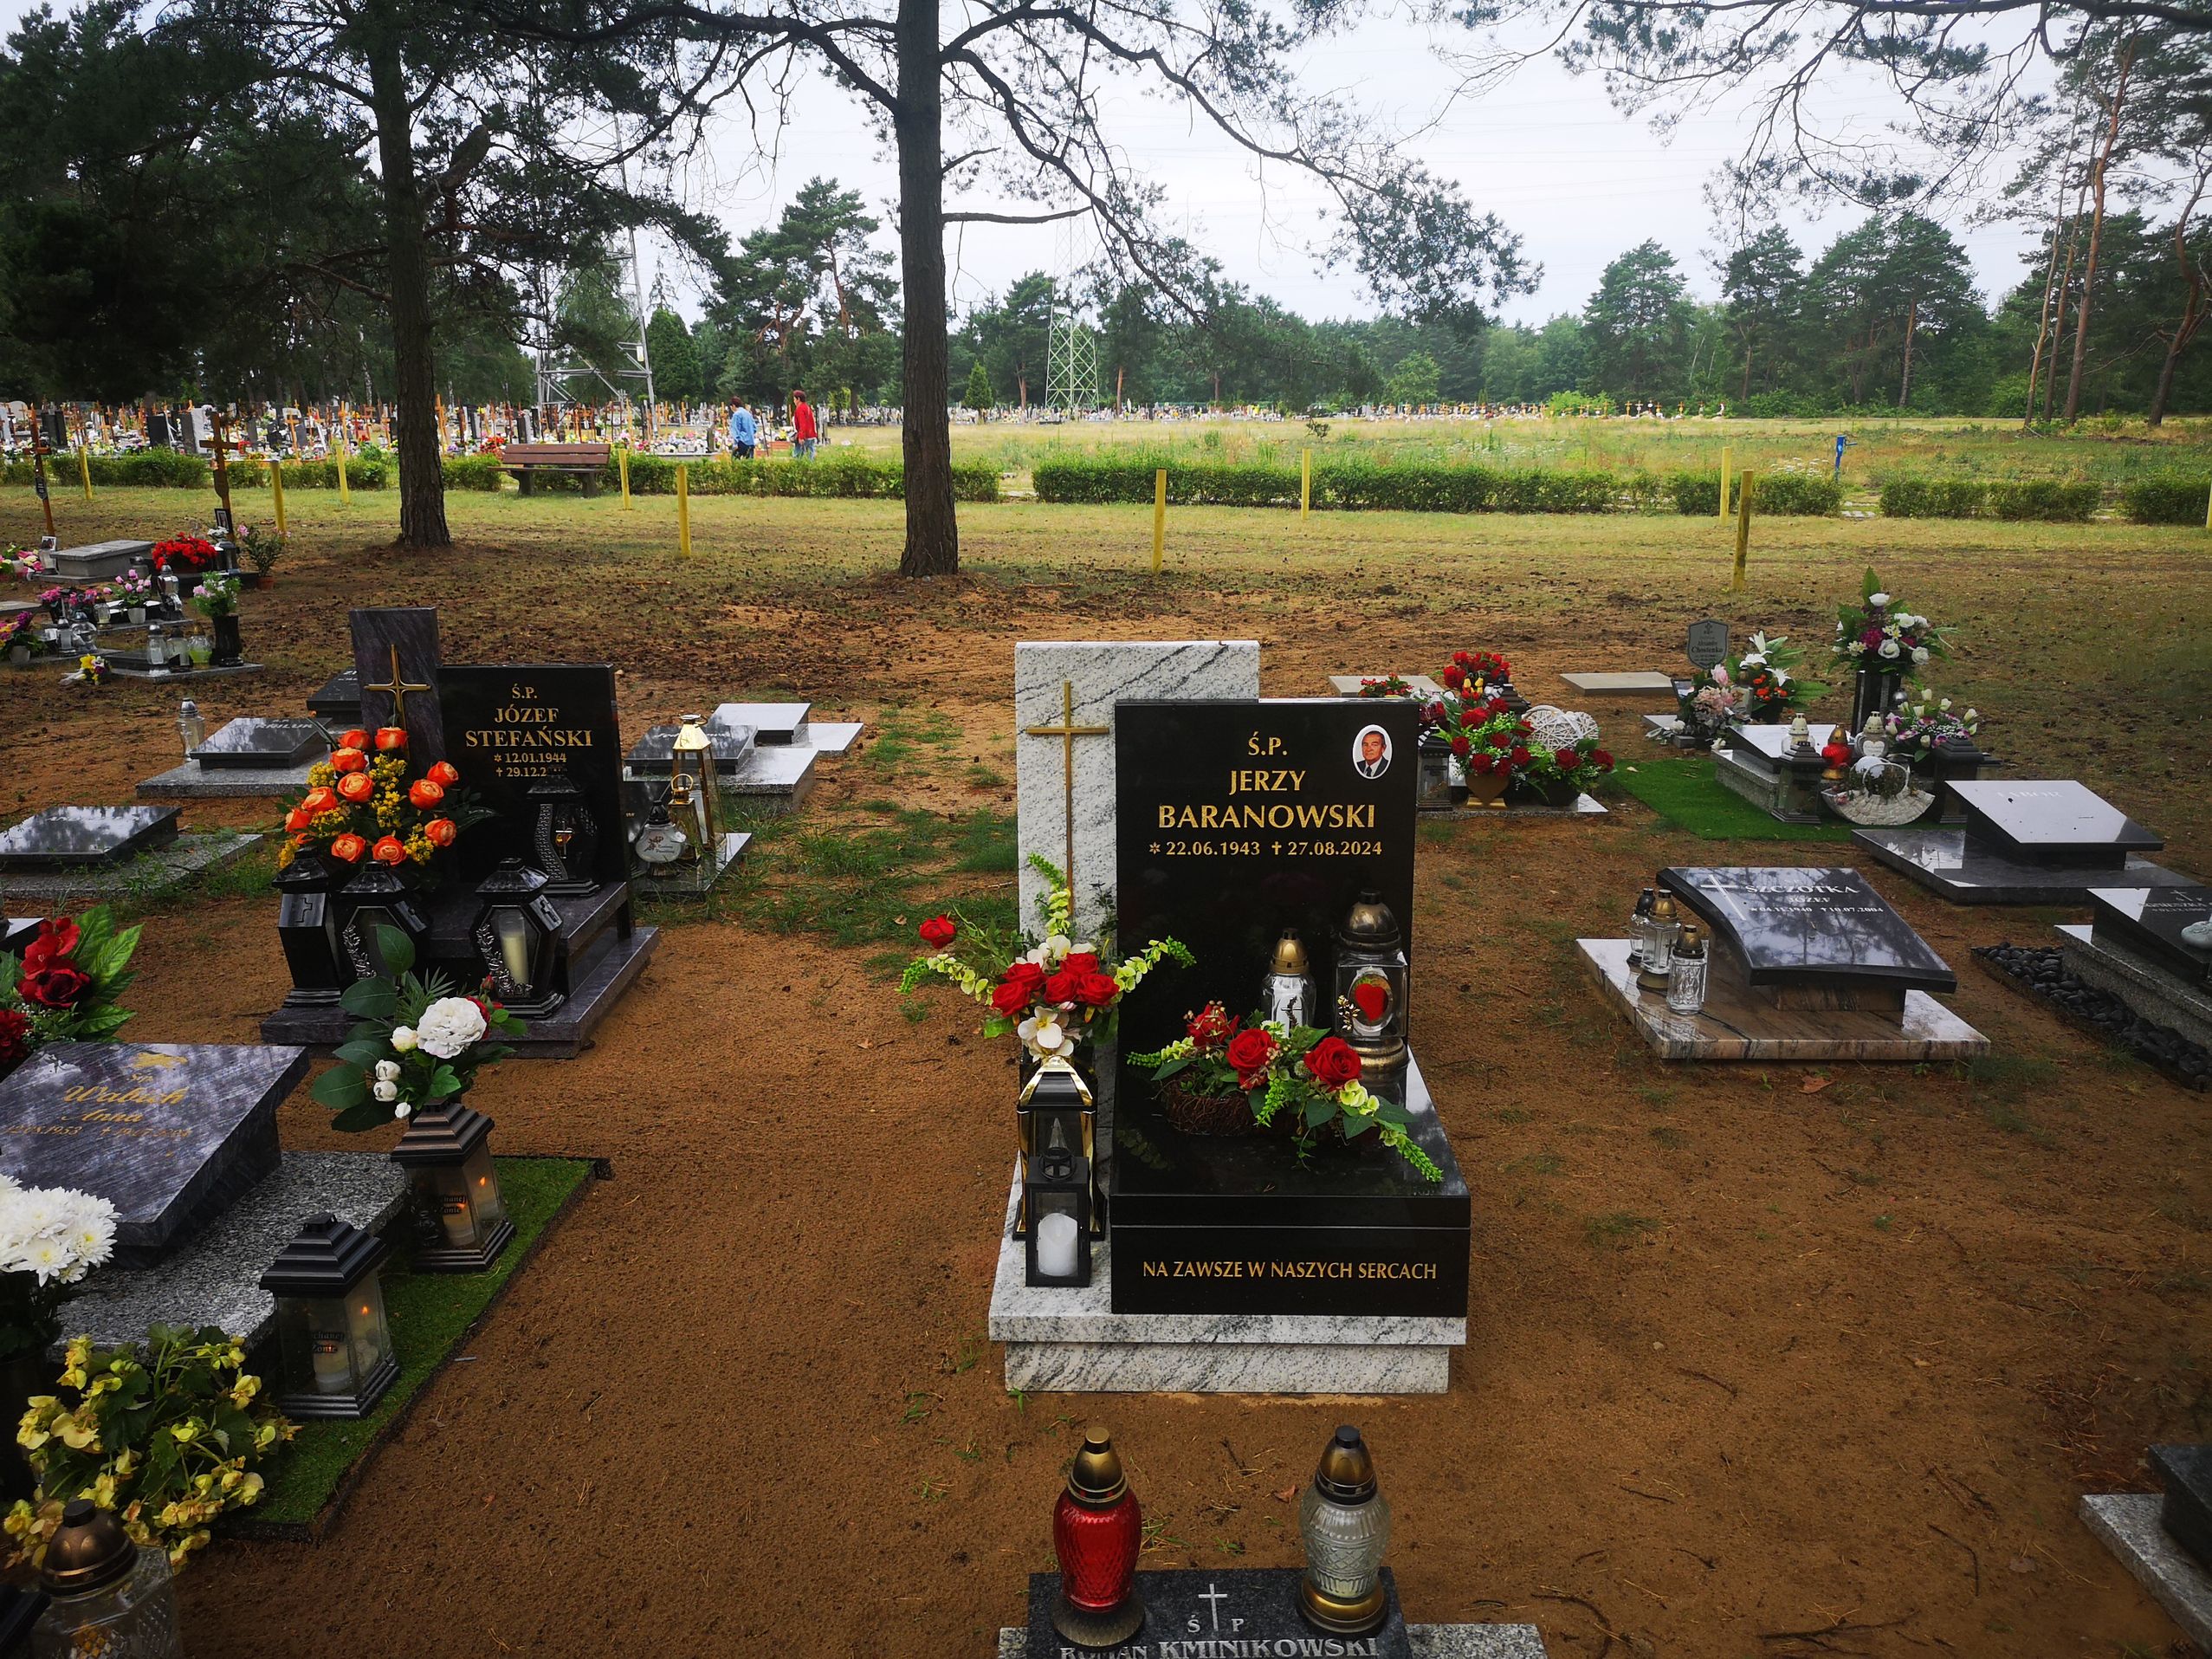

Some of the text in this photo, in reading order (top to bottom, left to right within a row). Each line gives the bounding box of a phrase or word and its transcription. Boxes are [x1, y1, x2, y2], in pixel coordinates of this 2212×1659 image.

[512, 683, 538, 699] Ś.P.
[494, 703, 559, 723] JÓZEF
[465, 725, 593, 748] STEFAŃSKI
[1247, 730, 1288, 756] Ś.P.
[505, 752, 567, 763] 12.01.1944
[506, 767, 549, 778] 29.12.2
[1228, 769, 1306, 796] JERZY
[1158, 804, 1375, 829] BARANOWSKI
[1166, 840, 1382, 856] 22.06.1943 27.08.2024
[1143, 1260, 1437, 1280] NA ZAWSZE W NASZYCH SERCACH
[1187, 1614, 1245, 1633] Ś P
[1158, 1637, 1380, 1659] KMINIKOWSKI
